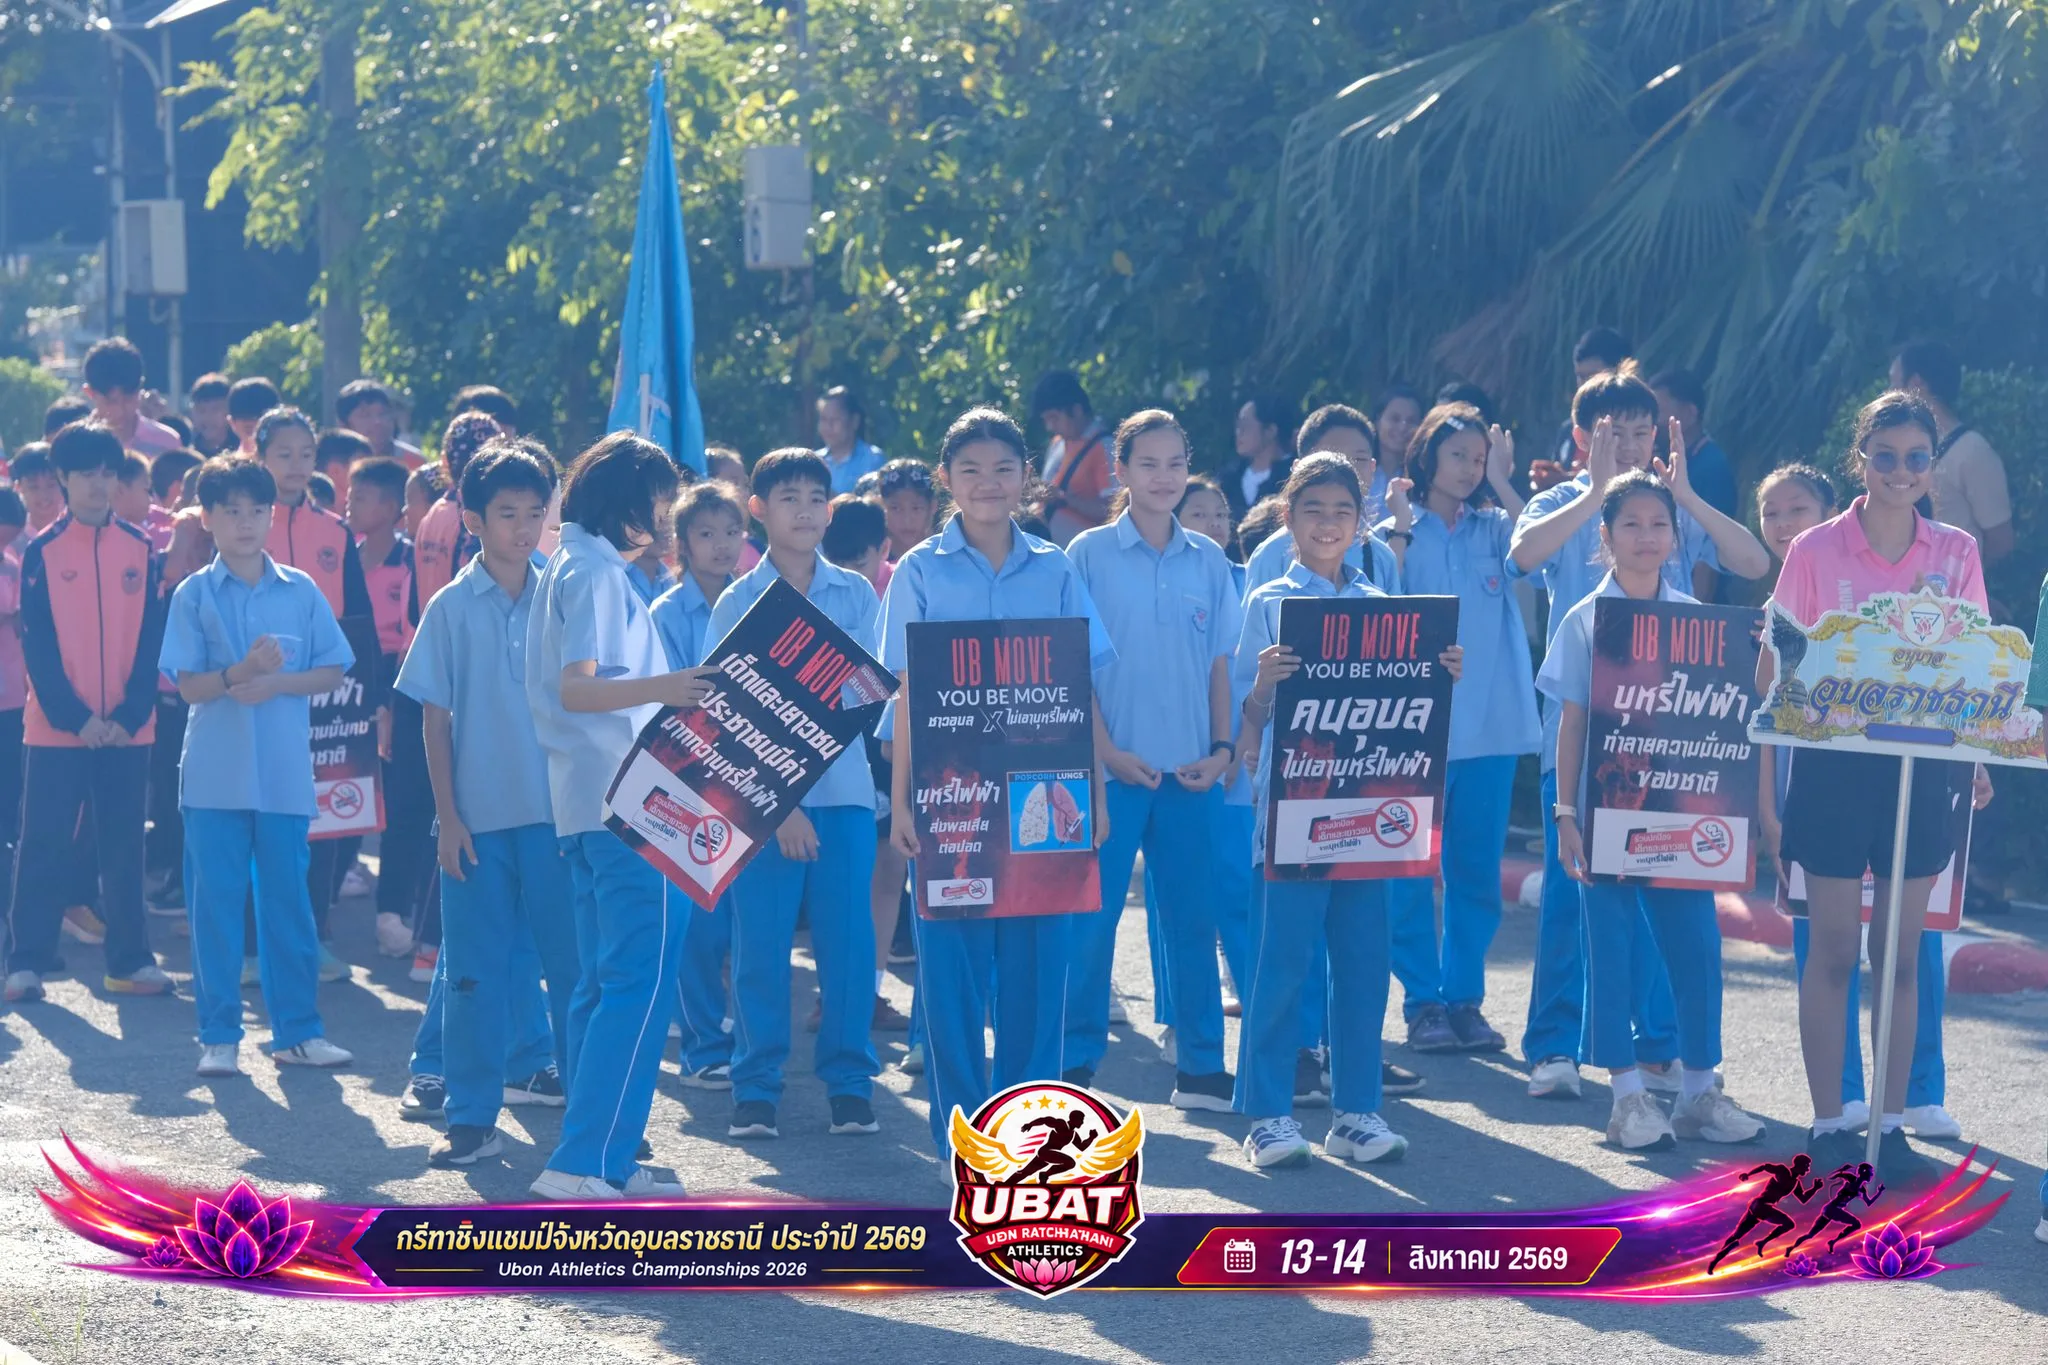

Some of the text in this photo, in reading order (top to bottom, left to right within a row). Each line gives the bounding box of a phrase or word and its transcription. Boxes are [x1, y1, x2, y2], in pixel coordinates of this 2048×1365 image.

[769, 616, 815, 667] UB
[1321, 613, 1420, 660] UB MOVE
[1632, 614, 1727, 667] UB MOVE
[952, 636, 1053, 687] UB MOVE
[1305, 662, 1432, 679] YOU BE MOVE
[718, 653, 843, 761] เด็กและเยาวชน
[928, 715, 974, 733] ชาวอุบล
[1006, 706, 1084, 730] ไม่เอาบุหรี่ไฟฟ้า
[937, 687, 1069, 707] YOU BE MOVE
[1613, 670, 1749, 727] บุหรี่ไฟฟ้า
[1807, 675, 2025, 727] อุบลราชธานี
[698, 691, 806, 787] ประชาชนมีค่า
[1290, 696, 1433, 753] คนอุบล
[1603, 729, 1751, 760] ทำลายความมั่นคง
[660, 715, 778, 816] มากกว่าบุหรี่ไฟฟ้า
[1056, 772, 1084, 780] LUNGS
[1282, 744, 1432, 788] ไม่เอาบุหรี่ไฟฟ้า
[1637, 769, 1719, 795] ของชาติ
[916, 776, 1000, 814] บุหรี่ไฟฟ้า
[929, 816, 990, 833] ส่งผลเสีย
[938, 838, 982, 854] ต่อปอด
